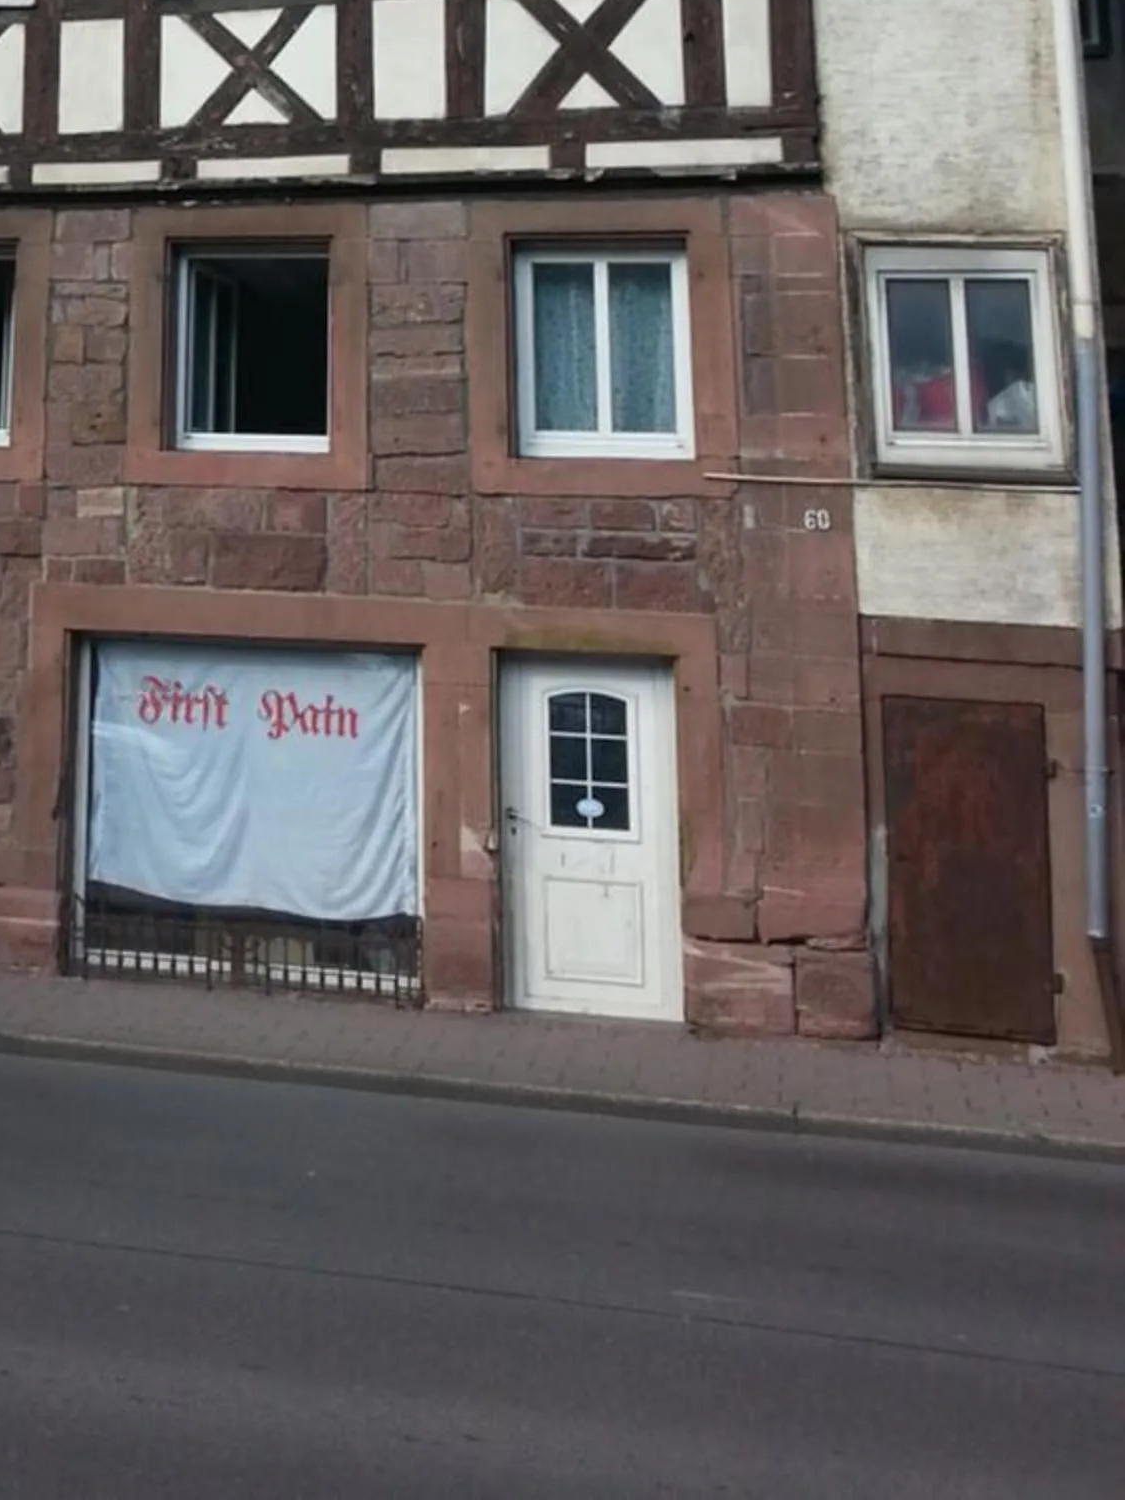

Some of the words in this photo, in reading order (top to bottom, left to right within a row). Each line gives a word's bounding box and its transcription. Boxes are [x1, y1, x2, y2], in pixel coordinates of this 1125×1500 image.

[804, 508, 830, 530] 60
[139, 675, 228, 731] First
[257, 688, 358, 740] Pain
